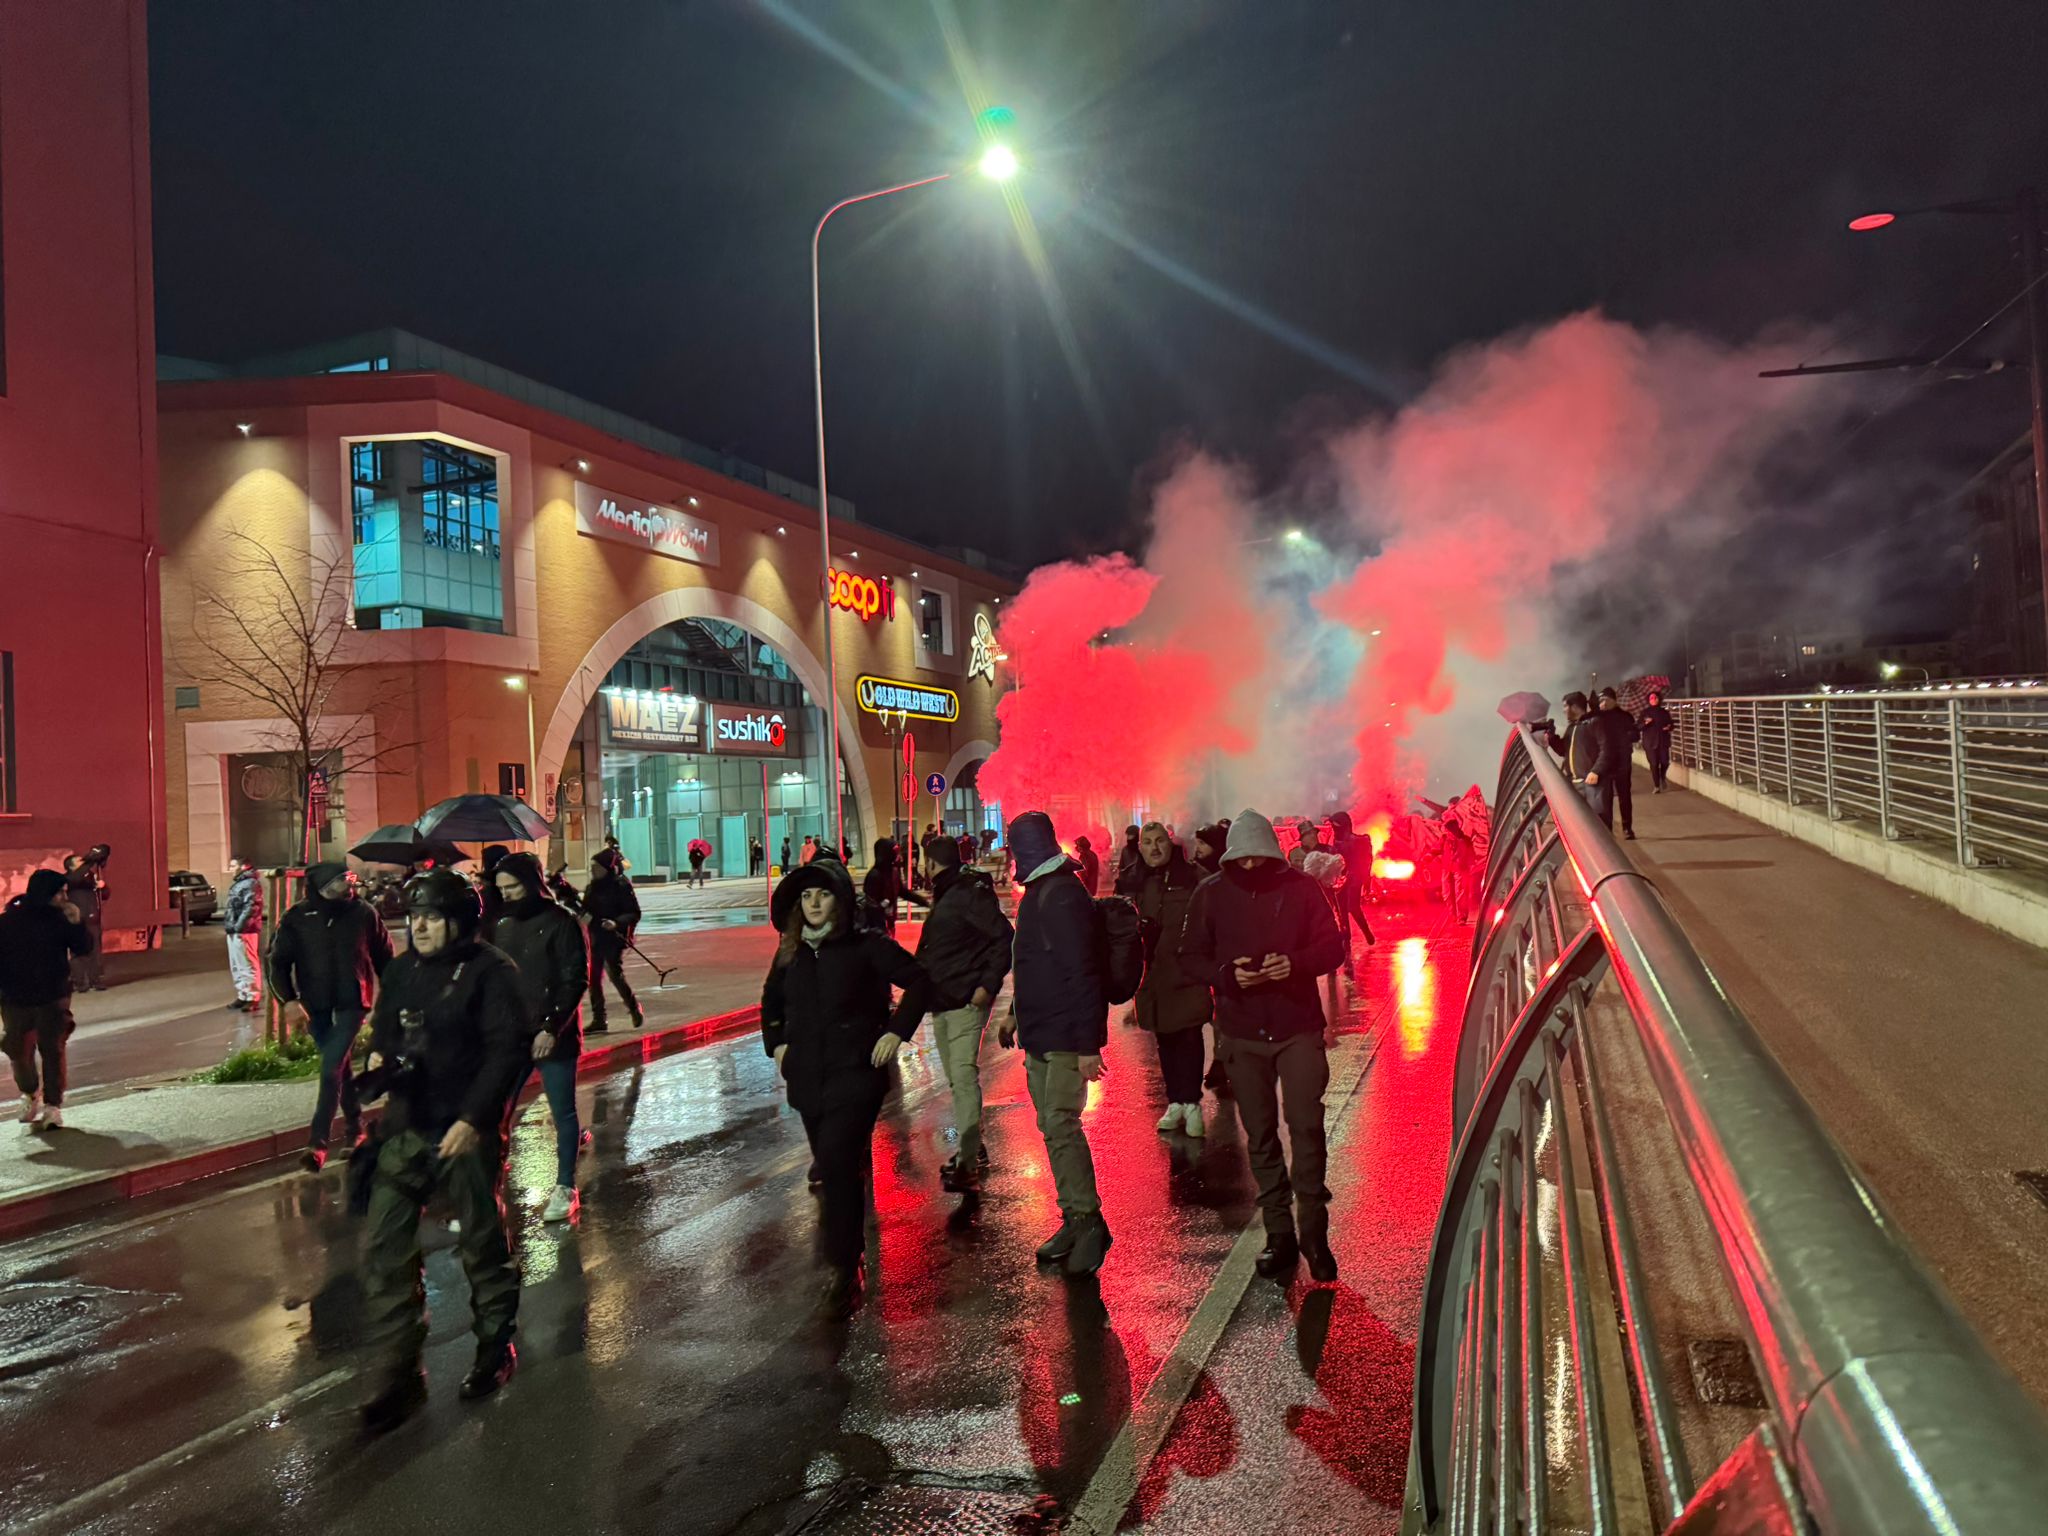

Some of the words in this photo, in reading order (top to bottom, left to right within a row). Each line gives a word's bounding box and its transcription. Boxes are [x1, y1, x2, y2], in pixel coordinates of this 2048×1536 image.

[874, 684, 895, 707] OLD
[895, 688, 920, 710] WILD
[920, 692, 946, 714] WEST
[718, 713, 785, 747] sushiko
